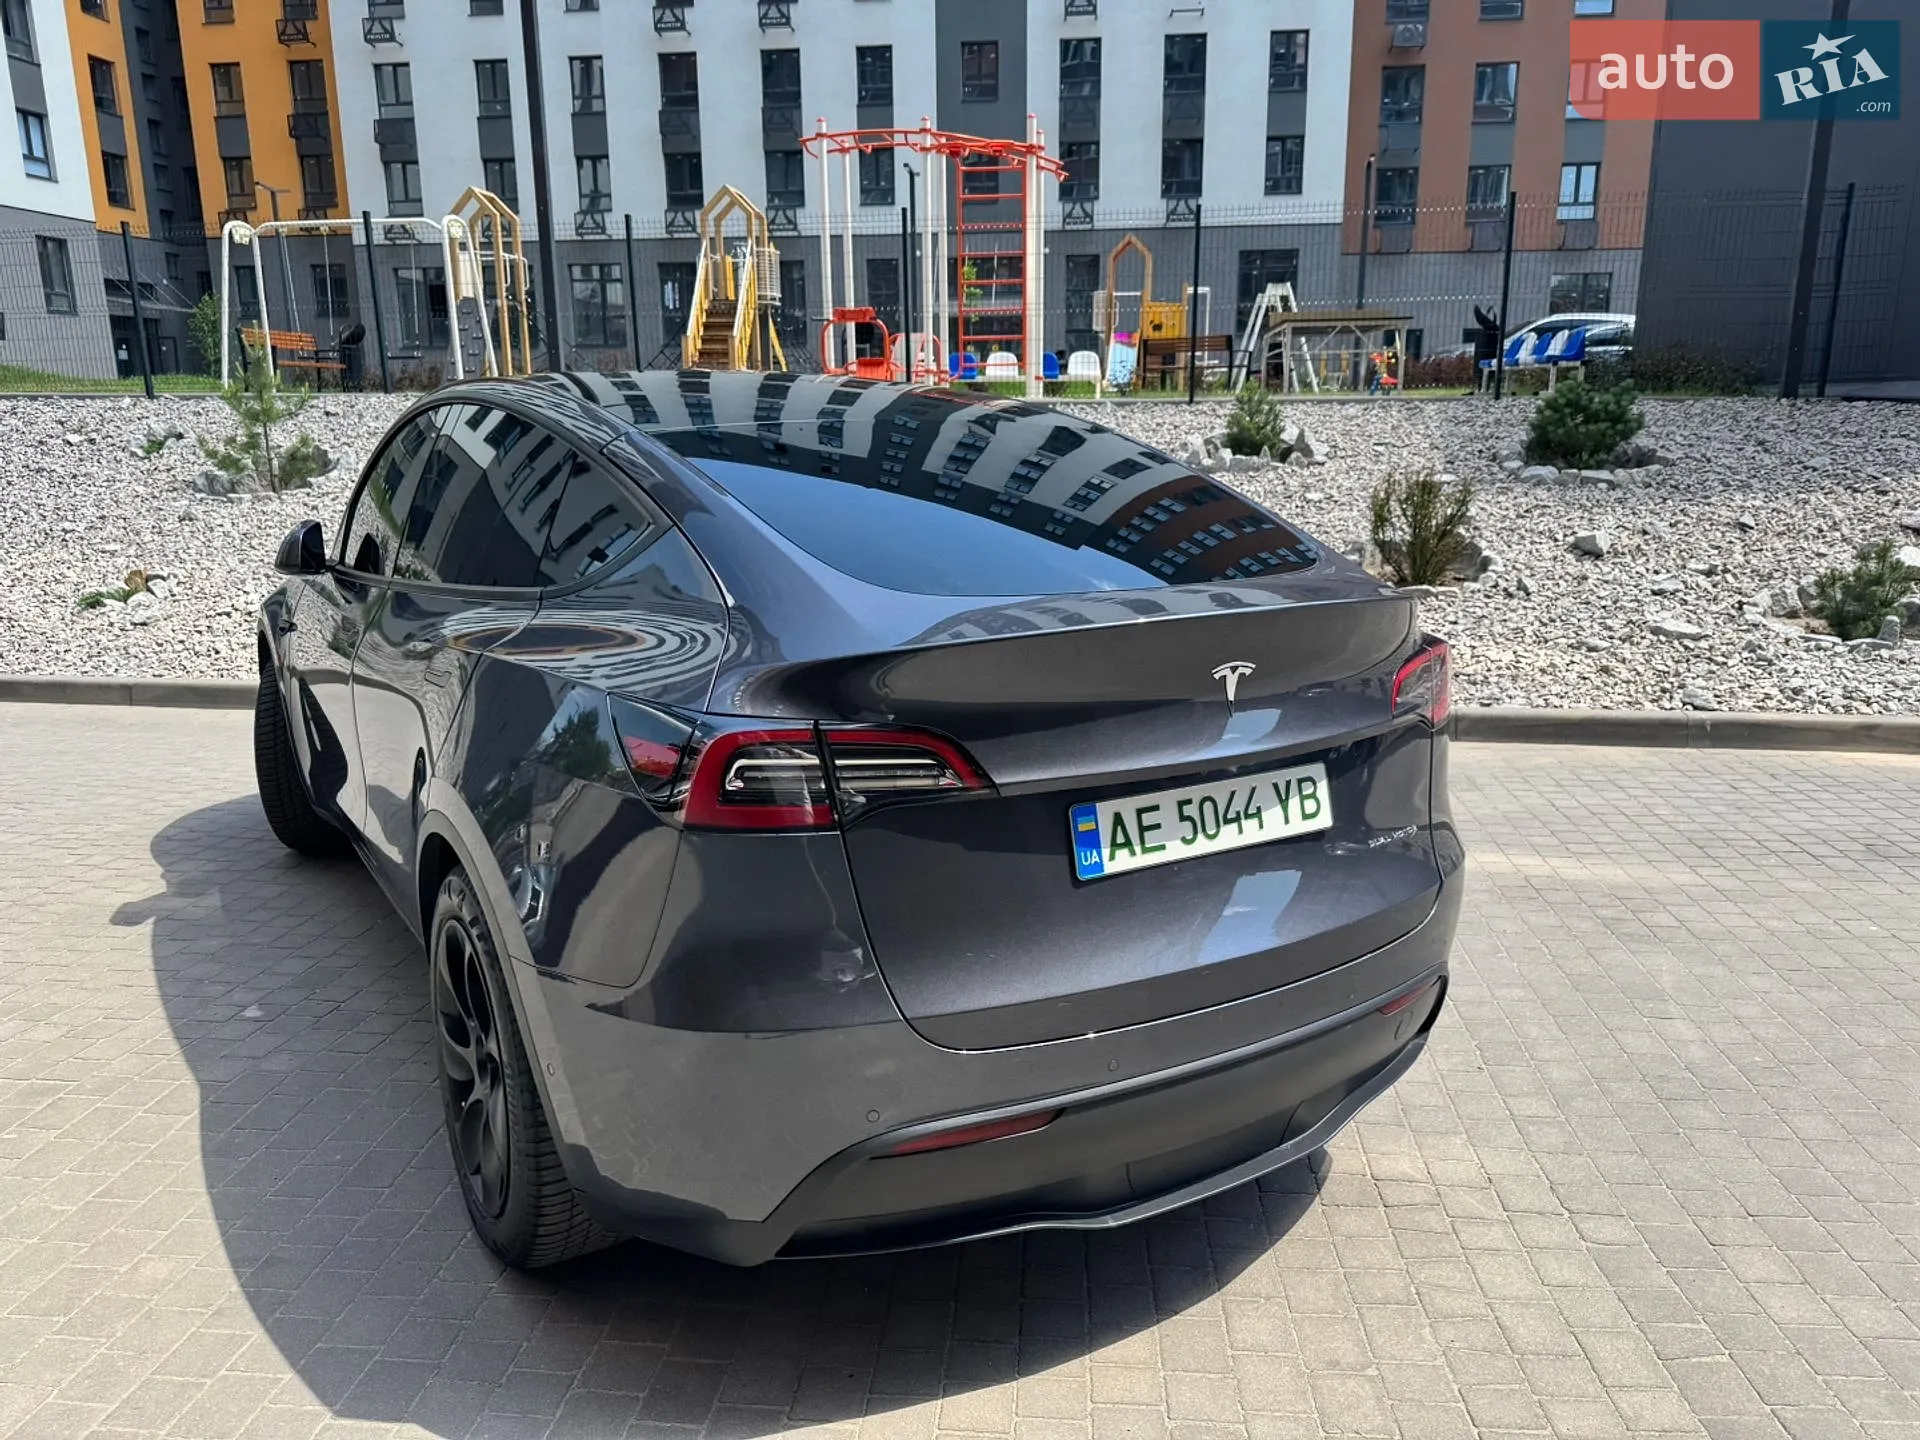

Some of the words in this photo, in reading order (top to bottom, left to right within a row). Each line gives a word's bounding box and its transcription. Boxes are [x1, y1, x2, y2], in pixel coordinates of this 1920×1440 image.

[1107, 804, 1167, 862] AE
[1176, 784, 1264, 846] 5044
[1271, 775, 1322, 826] YB
[1081, 848, 1101, 866] UA
